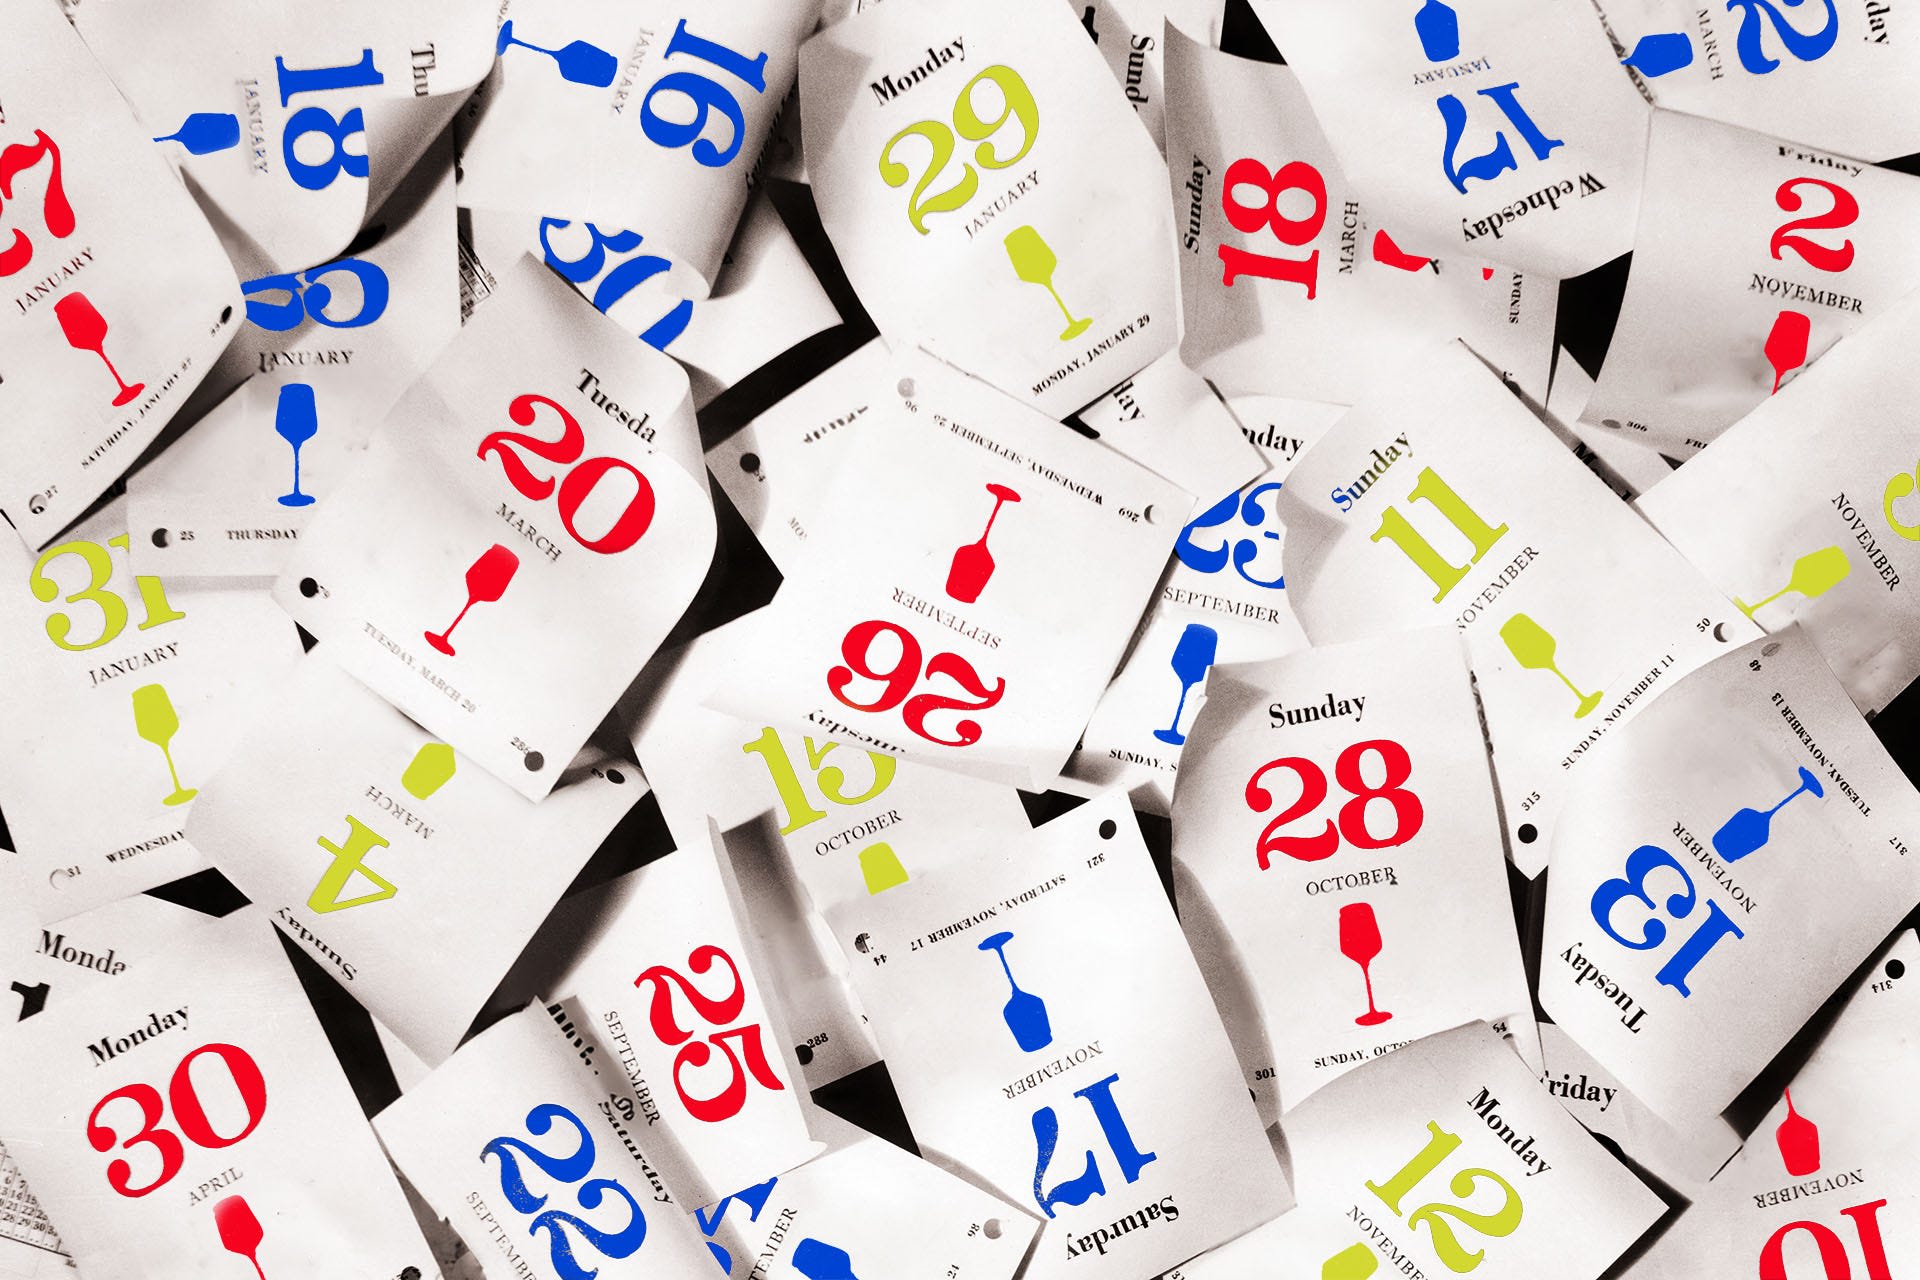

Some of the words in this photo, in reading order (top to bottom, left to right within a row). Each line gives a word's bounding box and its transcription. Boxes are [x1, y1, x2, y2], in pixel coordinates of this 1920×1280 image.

[611, 27, 654, 116] JANUARY
[869, 36, 968, 107] Monday
[1412, 56, 1492, 86] JANUARY
[1696, 8, 1725, 81] MARCH
[275, 48, 384, 190] 18
[640, 19, 768, 168] 16
[238, 79, 270, 175] JANUARY
[879, 64, 1040, 236] 29
[1437, 81, 1564, 195] 17
[1778, 146, 1863, 178] Friday
[963, 170, 1041, 241] JANUARY
[1183, 154, 1211, 255] Sunday
[1217, 157, 1328, 301] 18
[1338, 200, 1360, 275] MARCH
[1462, 172, 1607, 242] Wednesday
[1770, 177, 1859, 273] 2
[14, 246, 96, 315] JANUARY
[1508, 271, 1524, 324] SUNDAY
[1749, 273, 1864, 315] NOVEMBER
[258, 349, 353, 374] JANUARY
[1032, 360, 1086, 397] MONDAY,
[1086, 325, 1136, 363] JANUARY
[1137, 313, 1151, 330] 29
[81, 418, 138, 469] SATURDAY,
[138, 373, 179, 418] JANUARY
[575, 368, 657, 454] Tuesda
[950, 422, 1022, 465] SEPTEMBER
[477, 394, 656, 555] 20
[1029, 457, 1103, 506] WEDNESDAY,
[1331, 432, 1414, 512] Sunday
[179, 531, 195, 541] 25
[226, 528, 299, 541] THURSDAY
[496, 502, 562, 563] MARCH
[1117, 506, 1140, 524] 269
[1370, 466, 1509, 604] 11
[1831, 493, 1901, 592] NOVEMBER
[30, 533, 186, 651] 31
[892, 587, 1002, 650] SEPTEMBER
[1163, 586, 1281, 625] SEPTEMBER
[1456, 545, 1539, 634] NOVEMBER
[1696, 617, 1711, 633] 50
[89, 642, 179, 688] JANUARY
[363, 621, 417, 671] TUESDAY,
[418, 664, 461, 704] MARCH
[461, 699, 476, 714] 20
[826, 619, 1006, 747] 26
[1750, 658, 1762, 672] 48
[1268, 693, 1366, 730] Sunday
[1561, 726, 1607, 770] SUNDAY,
[1604, 669, 1660, 727] NOVEMBER
[1659, 654, 1675, 672] 11
[1771, 691, 1785, 706] 13
[1109, 748, 1164, 770] SUNDAY,
[1780, 705, 1831, 769] NOVEMBER
[365, 786, 434, 840] MARCH
[742, 726, 896, 836] 15
[1245, 739, 1424, 871] 28
[1521, 791, 1541, 812] 315
[1823, 763, 1872, 817] TUESDAY,
[105, 829, 187, 864] WEDNESDAY
[307, 814, 398, 914] 4
[815, 809, 903, 857] OCTOBER
[1086, 852, 1106, 869] 321
[1889, 836, 1908, 856] 317
[999, 873, 1067, 911] SATURDAY,
[1306, 866, 1397, 896] OCTOBER
[1672, 821, 1757, 913] NOVEMBER
[35, 928, 128, 977] Monda
[275, 906, 358, 981] Sunday
[910, 939, 924, 952] 17
[928, 906, 997, 944] NOVEMBER
[1590, 845, 1744, 998] 13
[874, 954, 887, 966] 44
[1560, 943, 1648, 1034] Tuesday
[1872, 979, 1893, 995] 314
[87, 1005, 190, 1068] Monday
[634, 944, 785, 1123] 25
[807, 1032, 829, 1049] 288
[1314, 1049, 1370, 1069] SUNDAY,
[604, 1010, 660, 1127] SEPTEMBER
[1002, 1040, 1103, 1100] NOVEMBER
[1254, 1067, 1277, 1081] 301
[1540, 1070, 1618, 1113] riday
[86, 1042, 267, 1198] 30
[598, 1101, 674, 1205] Saturday
[1031, 1072, 1157, 1219] 17
[1466, 1085, 1552, 1179] Monday
[189, 1167, 244, 1206] APRIL
[479, 1103, 647, 1280] 22
[1364, 1119, 1523, 1274] 12
[1753, 1167, 1865, 1209] NOVEMBER
[968, 1223, 980, 1238] 98
[1066, 1195, 1180, 1261] Saturday
[1759, 1198, 1893, 1280] 10
[947, 1264, 960, 1279] 24
